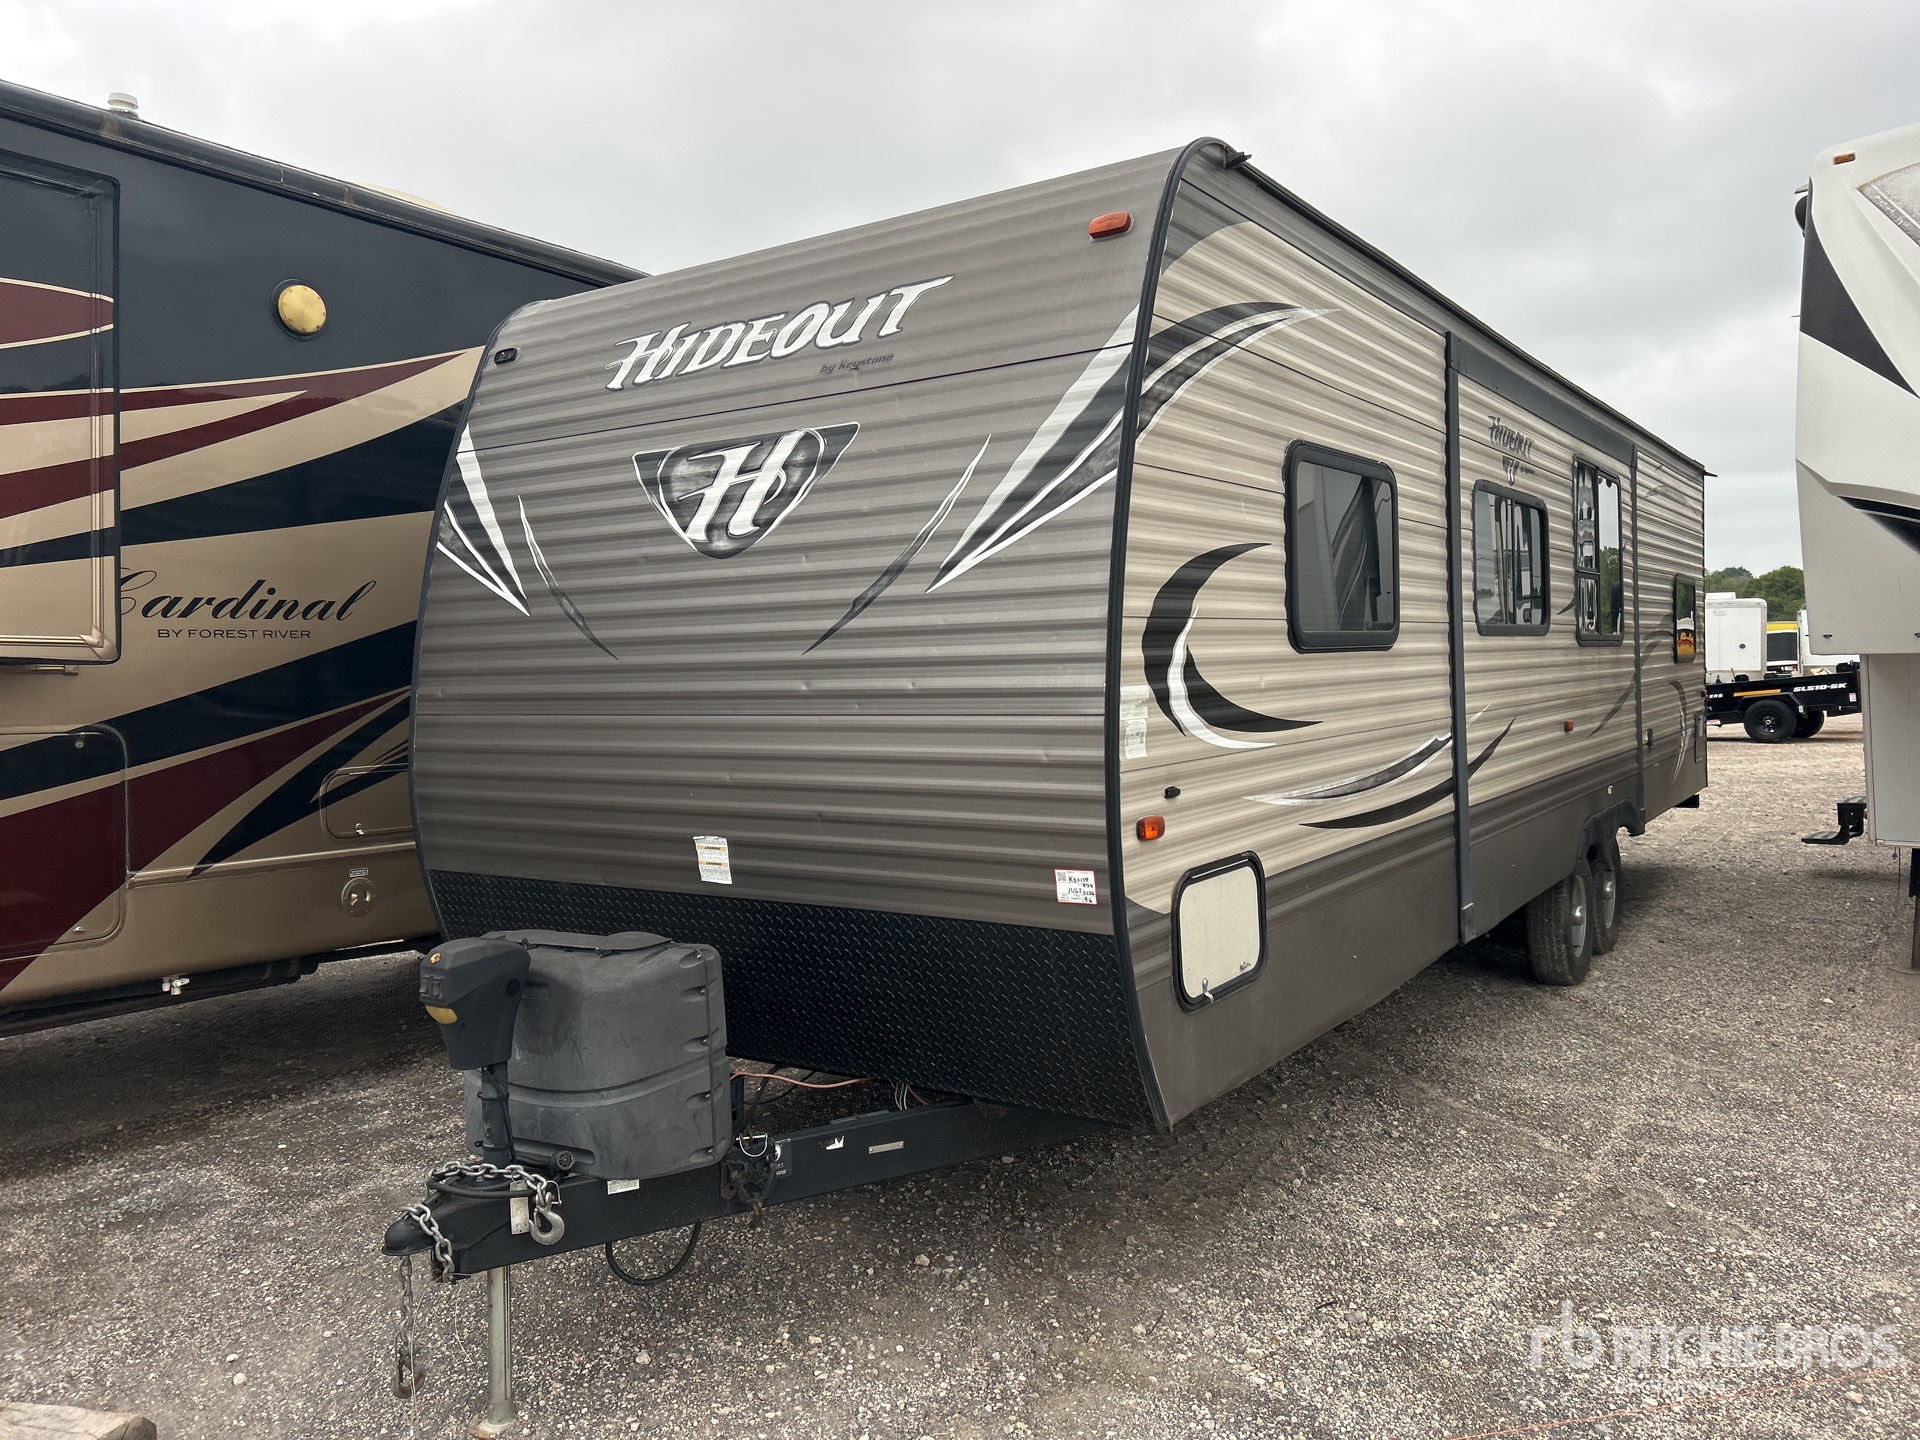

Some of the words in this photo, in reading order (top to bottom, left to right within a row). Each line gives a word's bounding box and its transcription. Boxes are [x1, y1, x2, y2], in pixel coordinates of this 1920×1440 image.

[604, 275, 955, 391] HIDEOUT
[820, 364, 836, 375] by
[838, 353, 895, 371] Keystone
[157, 628, 183, 639] BY
[188, 628, 259, 639] FOREST
[262, 629, 311, 639] RIVER
